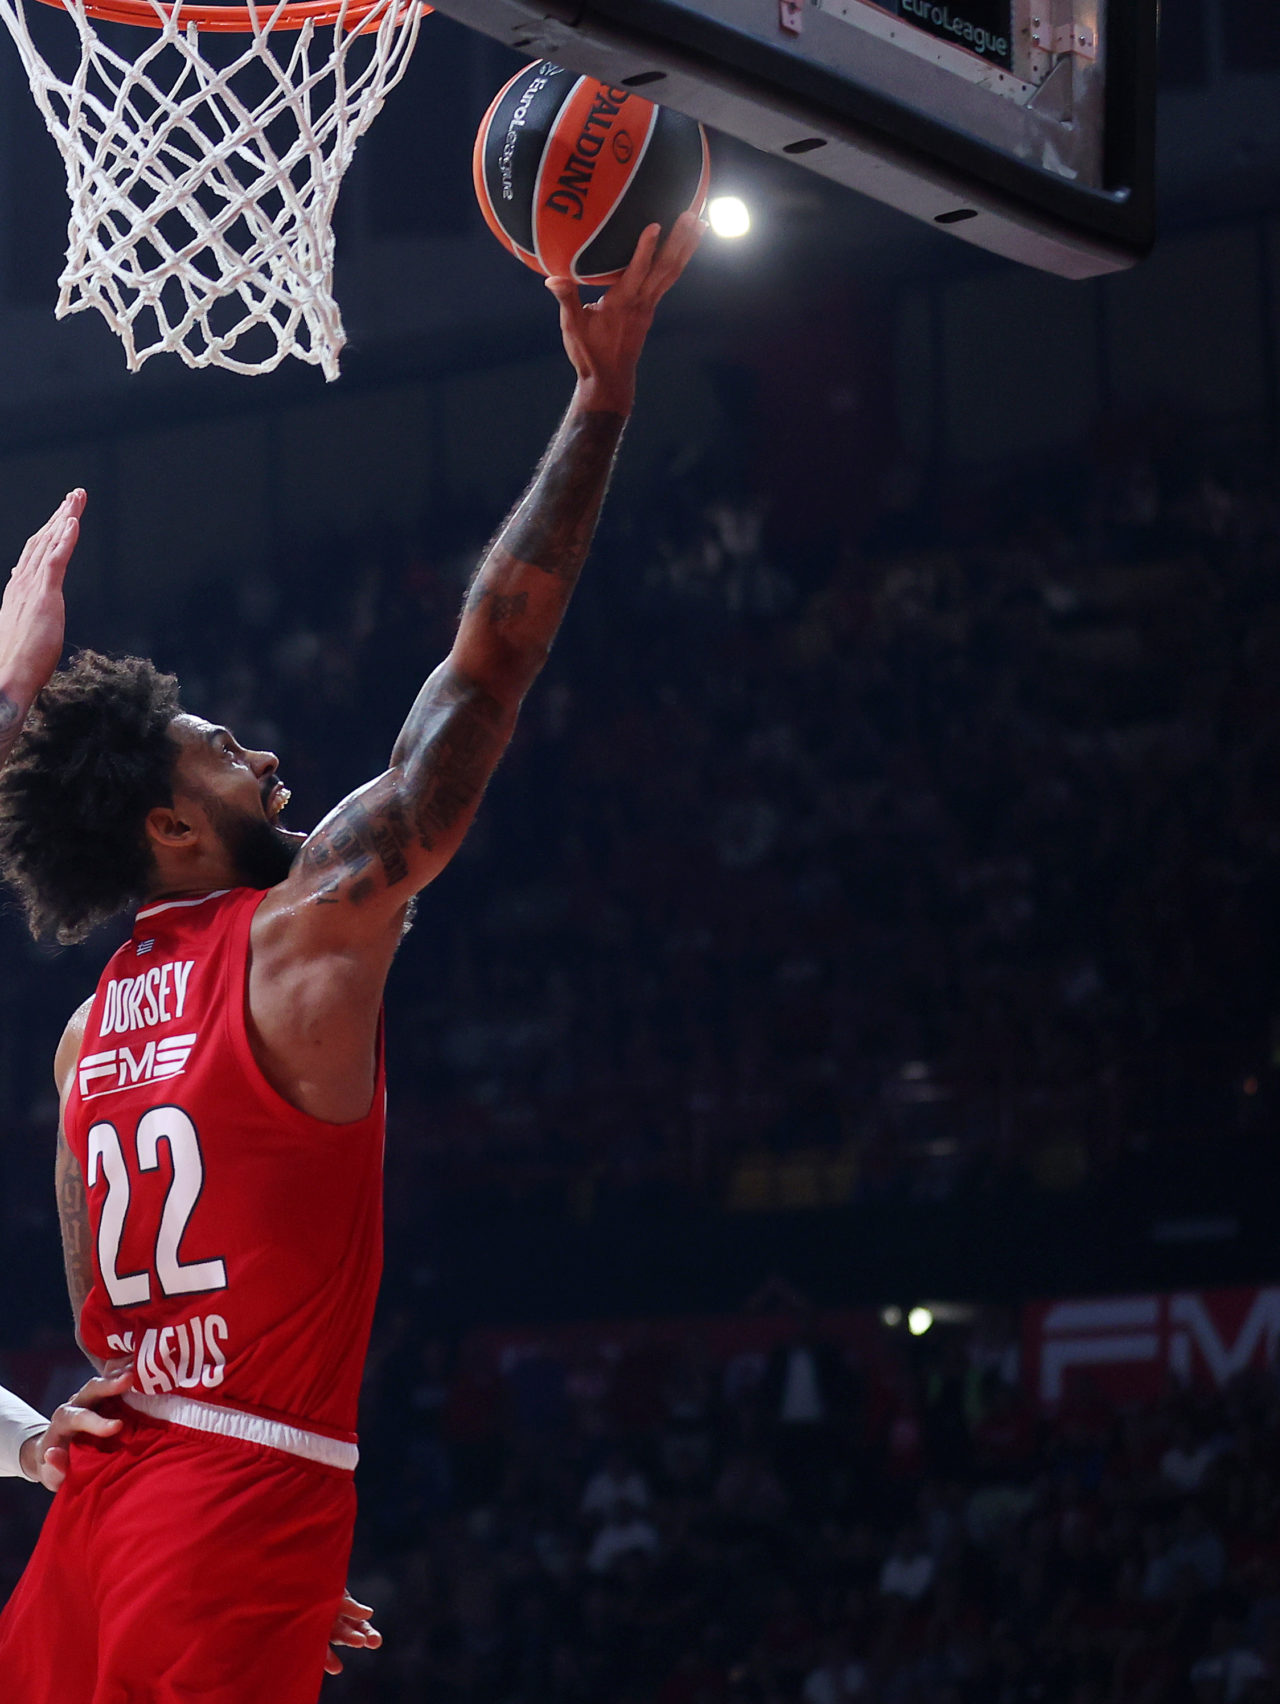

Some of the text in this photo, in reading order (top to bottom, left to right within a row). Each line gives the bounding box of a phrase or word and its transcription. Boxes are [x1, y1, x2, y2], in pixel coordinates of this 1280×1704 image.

[498, 77, 548, 201] EuroLeague
[545, 81, 631, 220] PALDING
[99, 960, 195, 1037] DORSEY
[79, 1032, 197, 1096] FMS
[87, 1104, 228, 1307] 22
